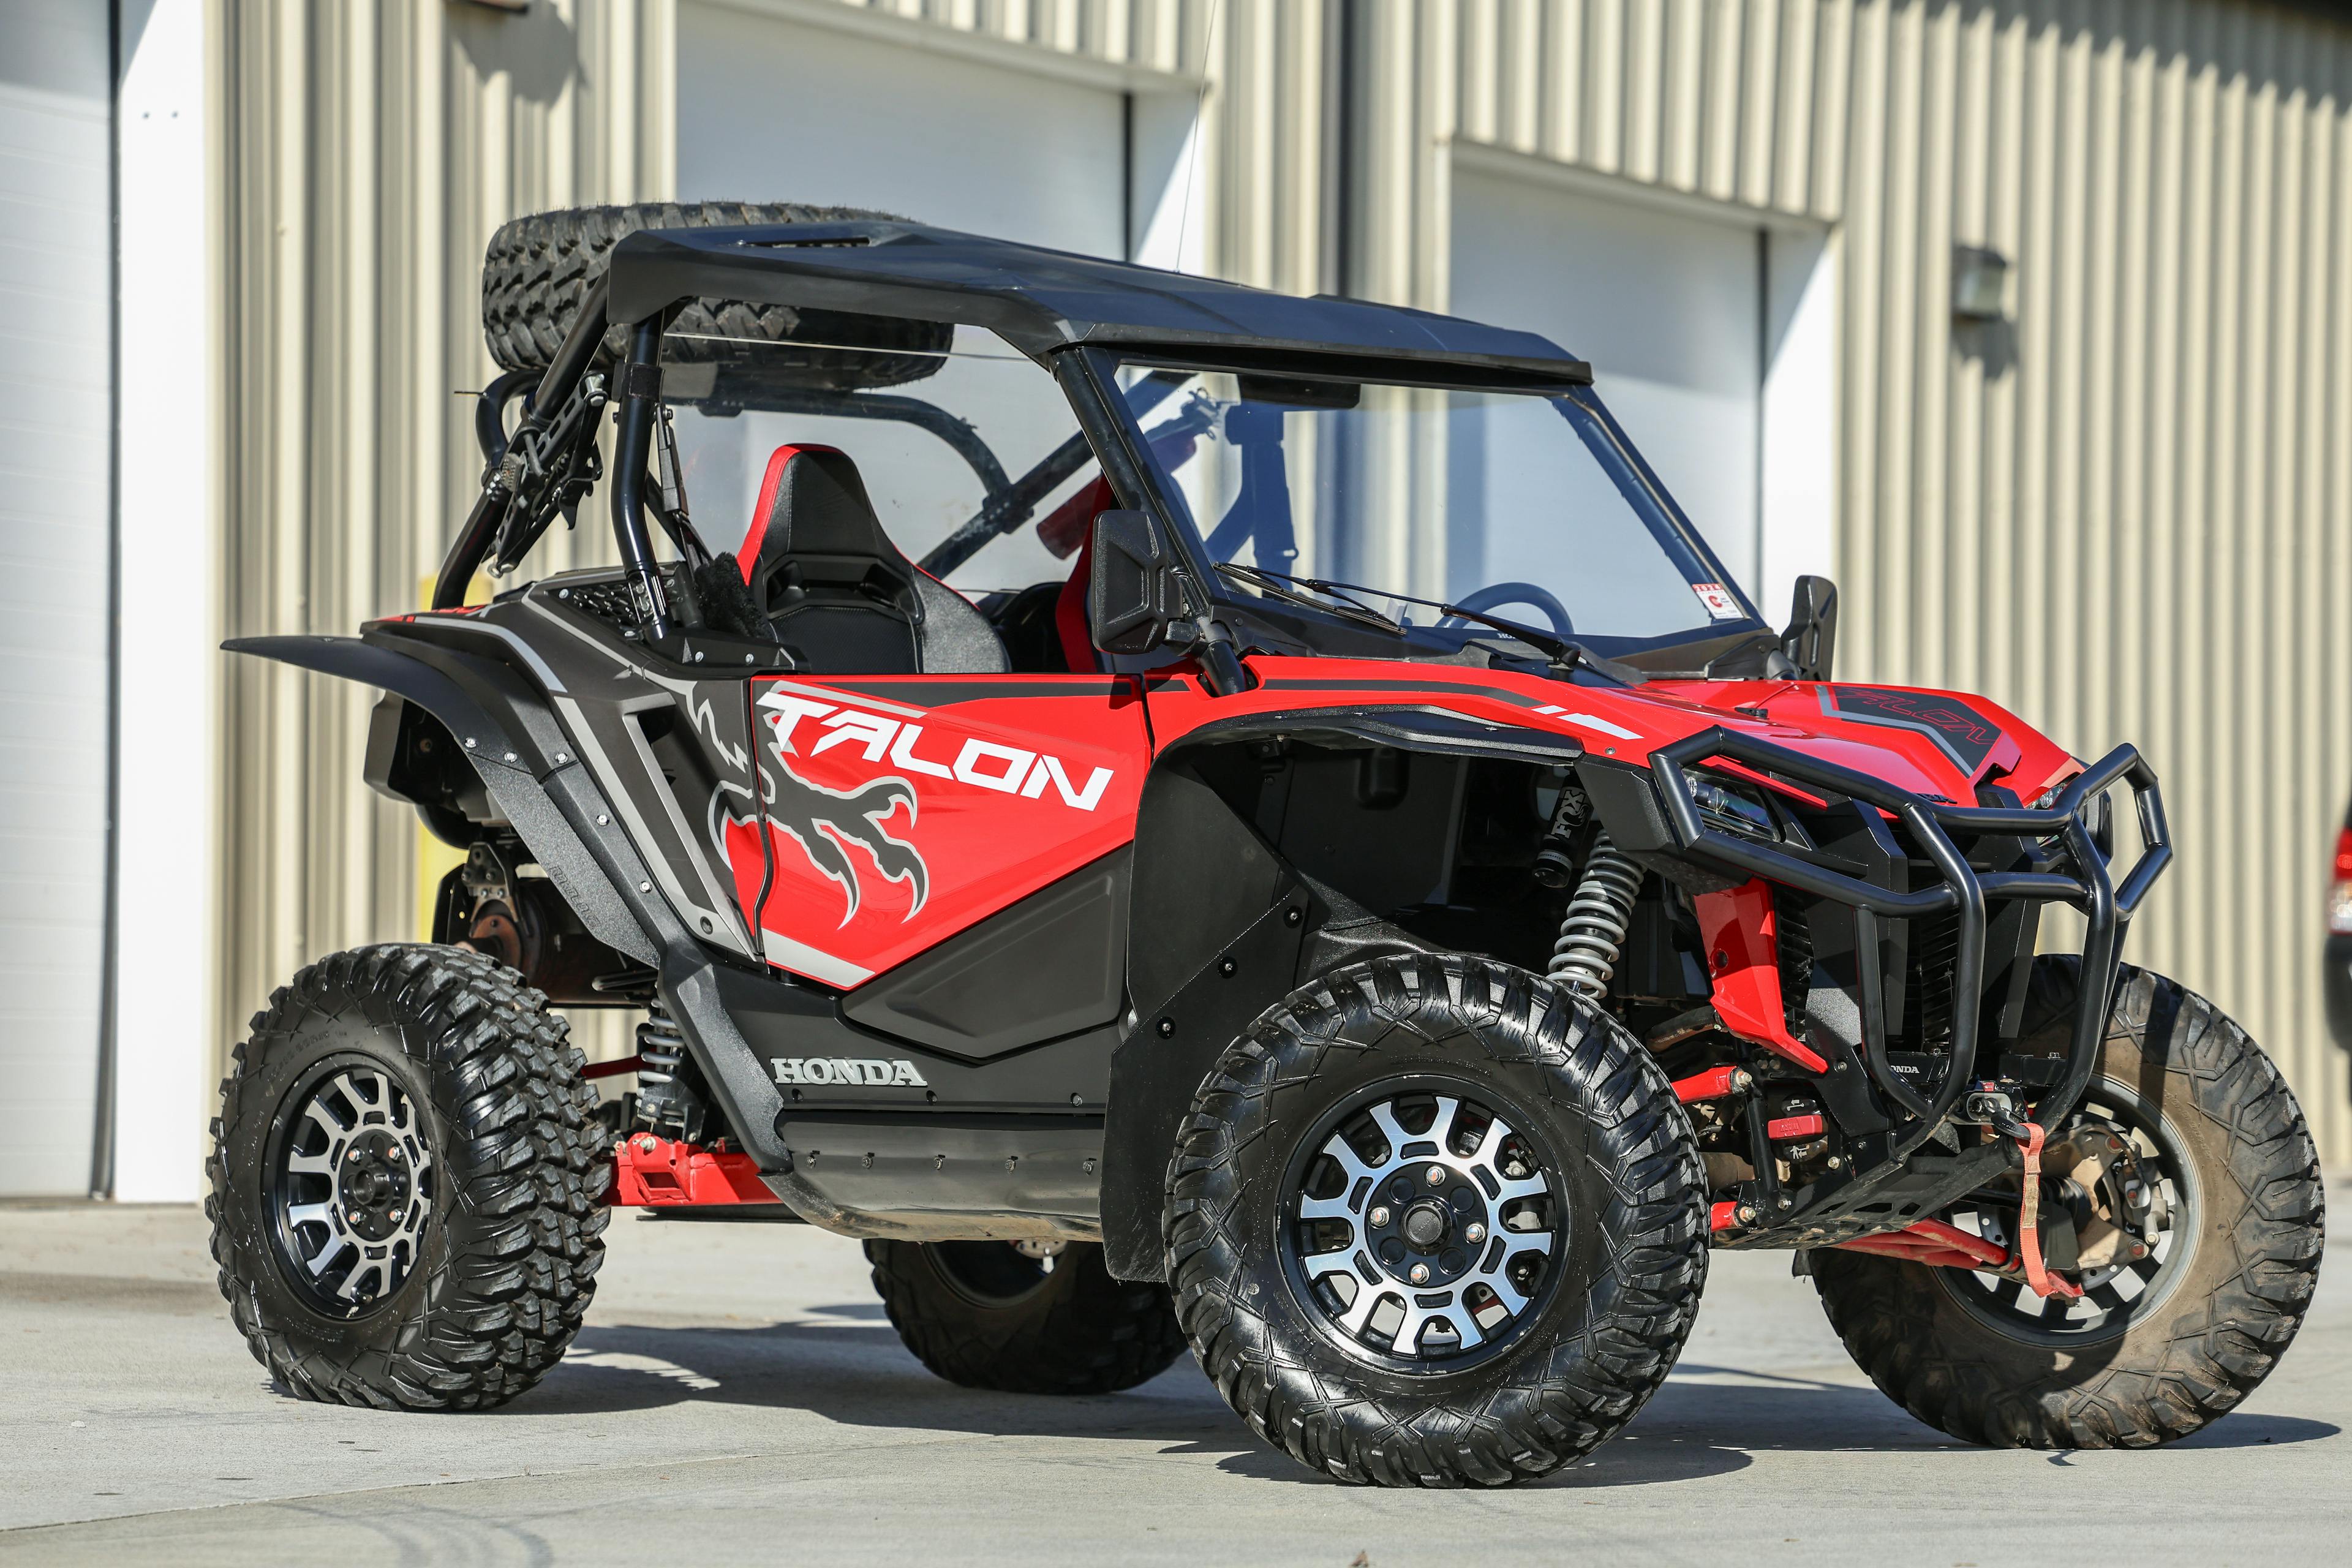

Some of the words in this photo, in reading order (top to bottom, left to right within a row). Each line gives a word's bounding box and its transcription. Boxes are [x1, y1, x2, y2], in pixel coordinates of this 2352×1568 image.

[756, 691, 1114, 812] TALON
[771, 1058, 928, 1087] HONDA
[1890, 1065, 1920, 1074] ONDA
